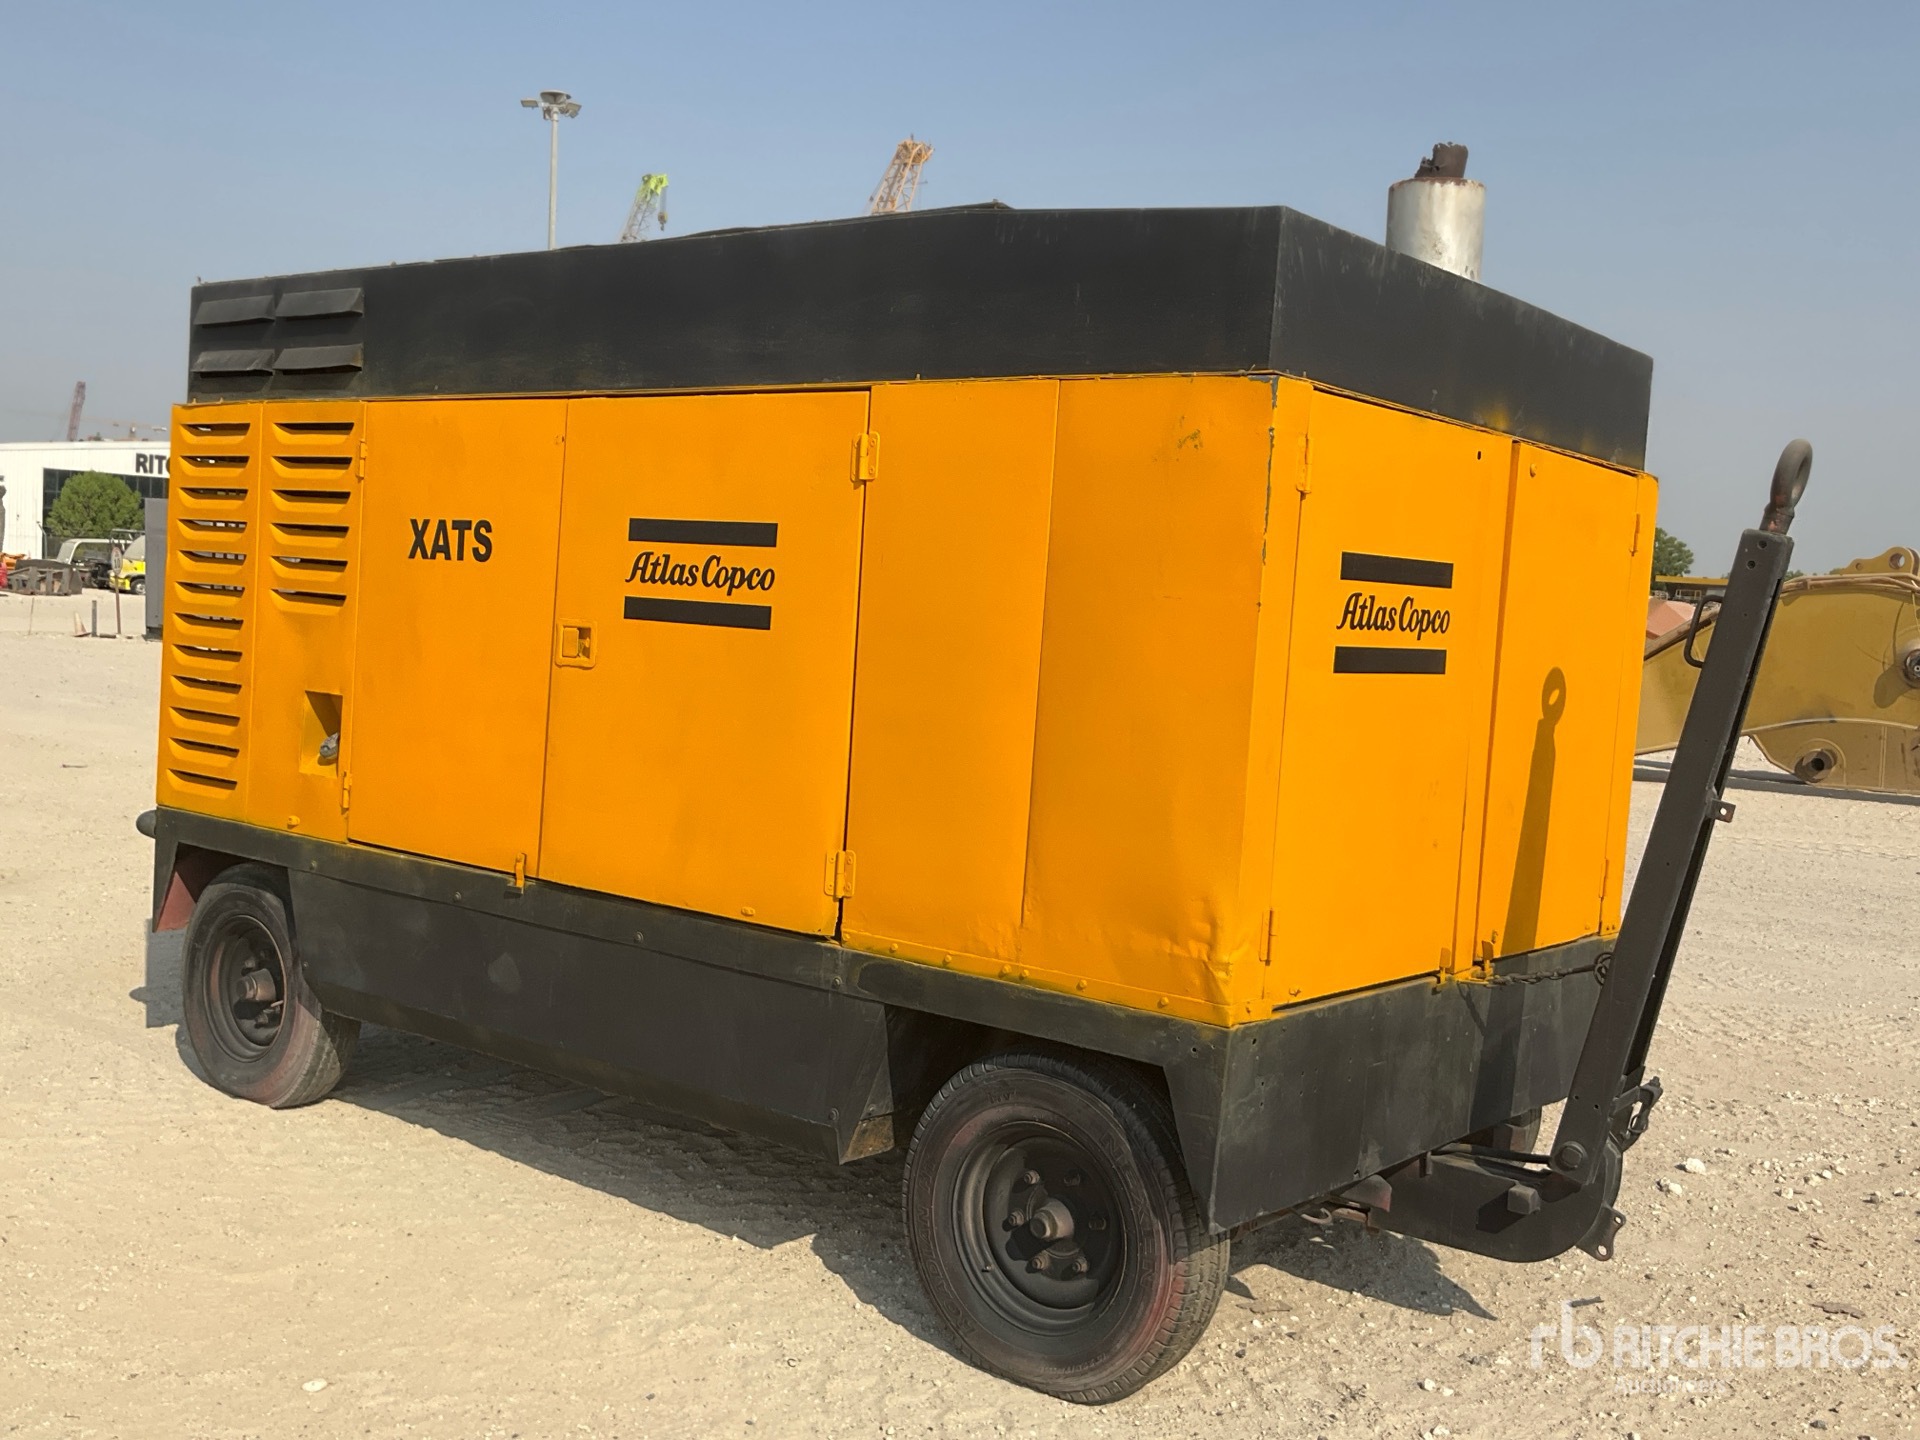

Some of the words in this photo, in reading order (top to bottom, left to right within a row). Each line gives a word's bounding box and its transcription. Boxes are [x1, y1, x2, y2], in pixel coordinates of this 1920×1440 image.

[408, 518, 493, 562] XATS
[625, 551, 698, 586] Atlas
[702, 555, 775, 596] Copco
[1336, 592, 1397, 631] Atlas
[1399, 596, 1450, 640] Copco
[1100, 1131, 1156, 1290] NEXEN
[917, 1207, 976, 1338] ROADIAN
